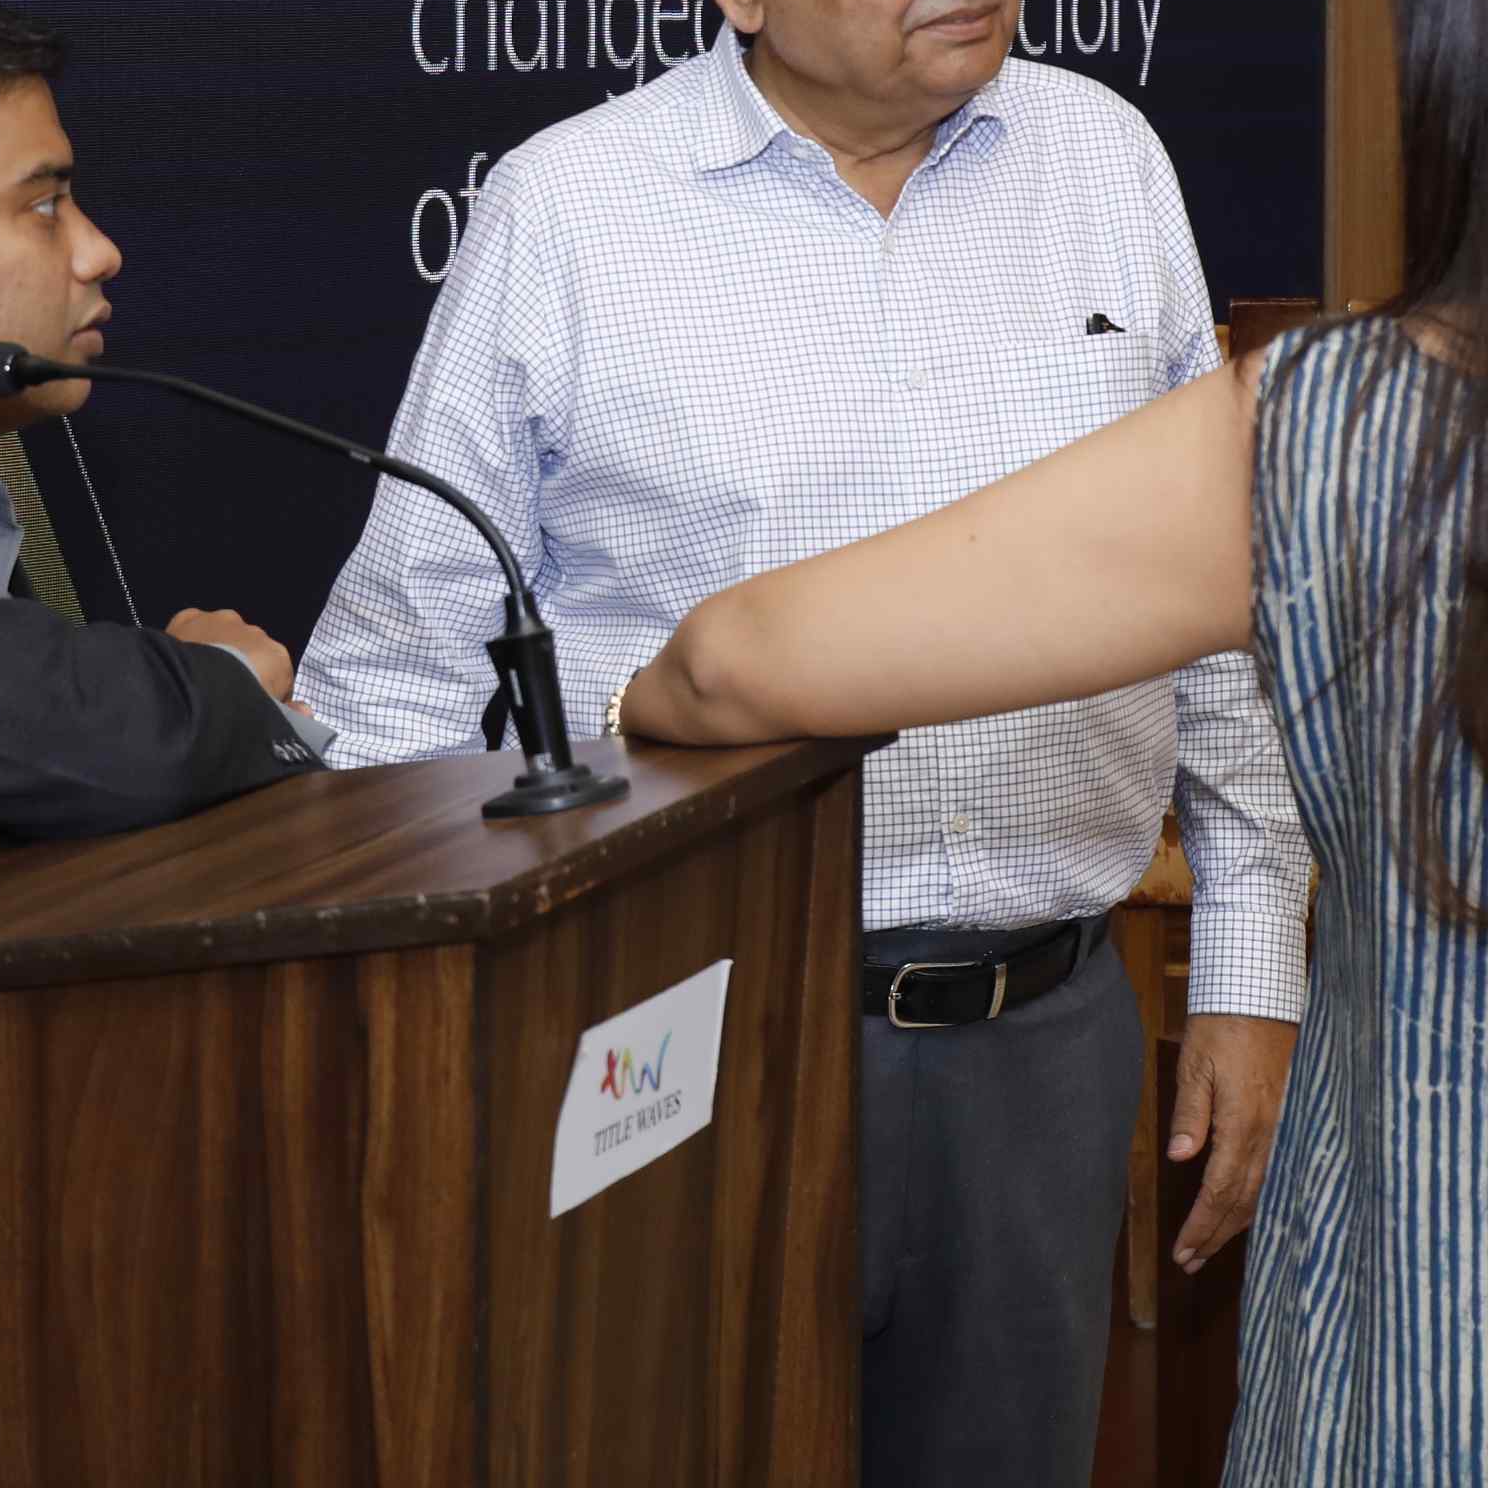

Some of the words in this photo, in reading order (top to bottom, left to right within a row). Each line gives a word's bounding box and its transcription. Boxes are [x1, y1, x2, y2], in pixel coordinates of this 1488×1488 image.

[410, 152, 489, 285] of
[593, 1114, 636, 1158] TITLE
[636, 1088, 683, 1134] WAVES
